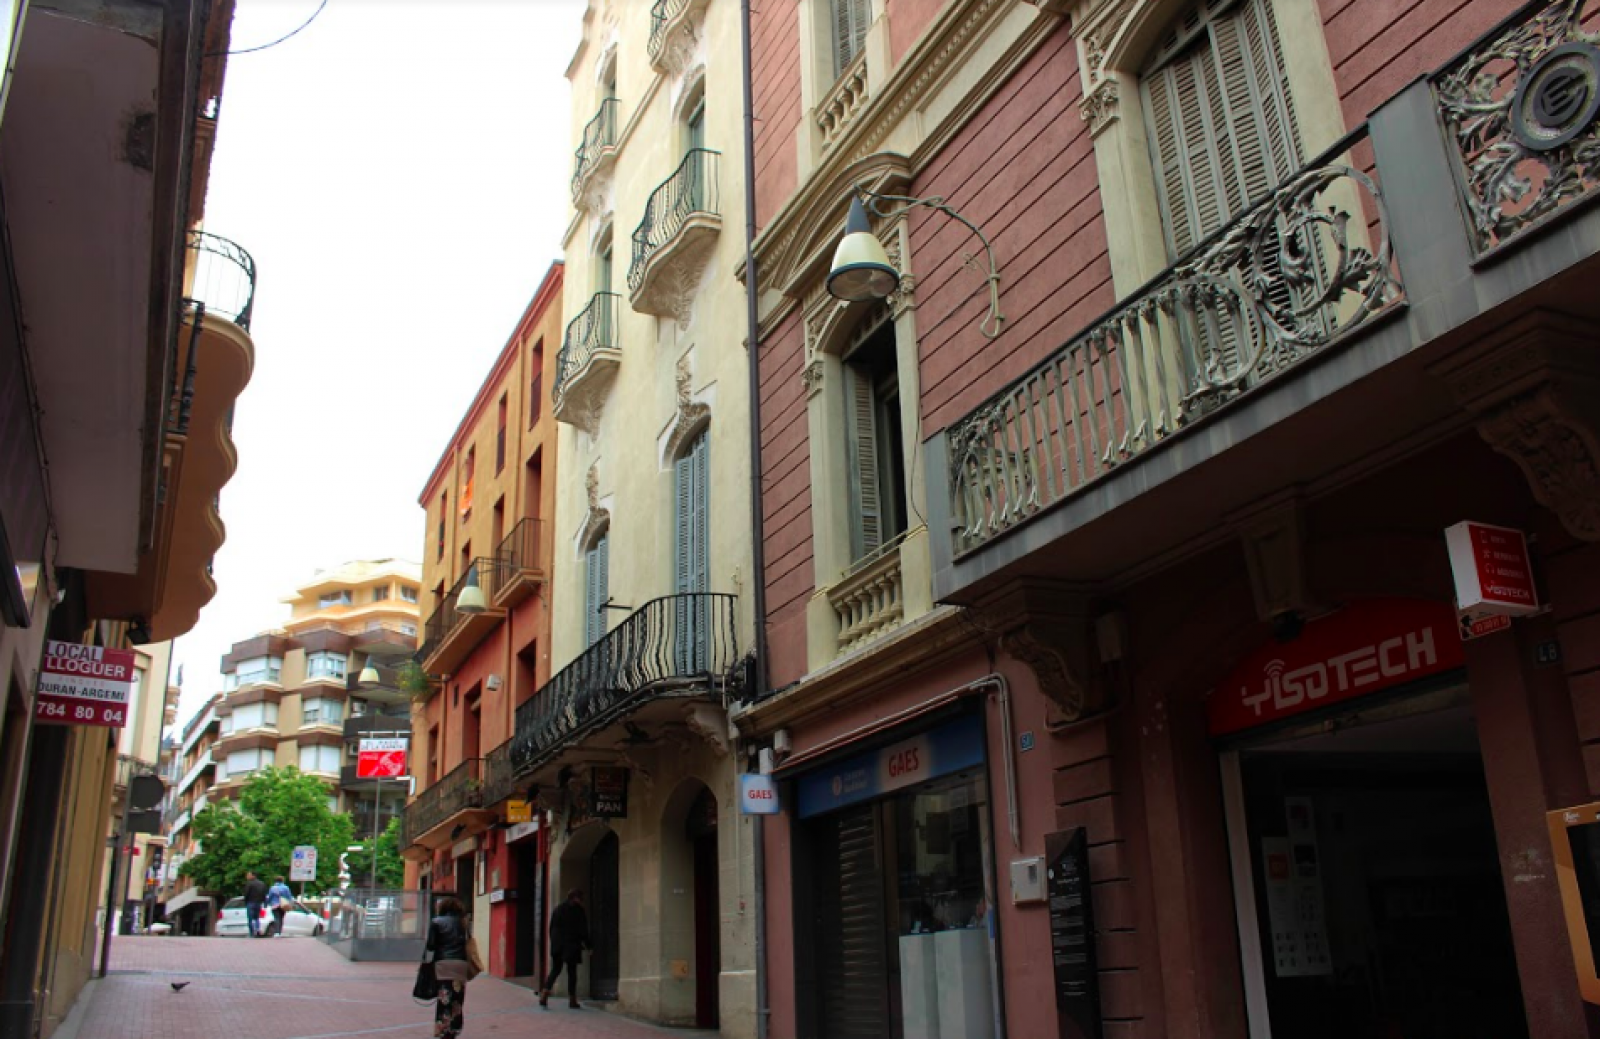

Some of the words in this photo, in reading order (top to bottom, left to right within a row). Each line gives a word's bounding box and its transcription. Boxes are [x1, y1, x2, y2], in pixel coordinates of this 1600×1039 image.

[45, 641, 101, 662] LOCAL
[46, 656, 125, 678] LLOGUER
[1241, 626, 1437, 716] YISOTECH
[37, 701, 66, 716] 784
[75, 705, 94, 719] 80
[103, 709, 122, 722] 04
[888, 748, 919, 777] GAES
[747, 789, 773, 800] GAES
[596, 801, 622, 812] PAN
